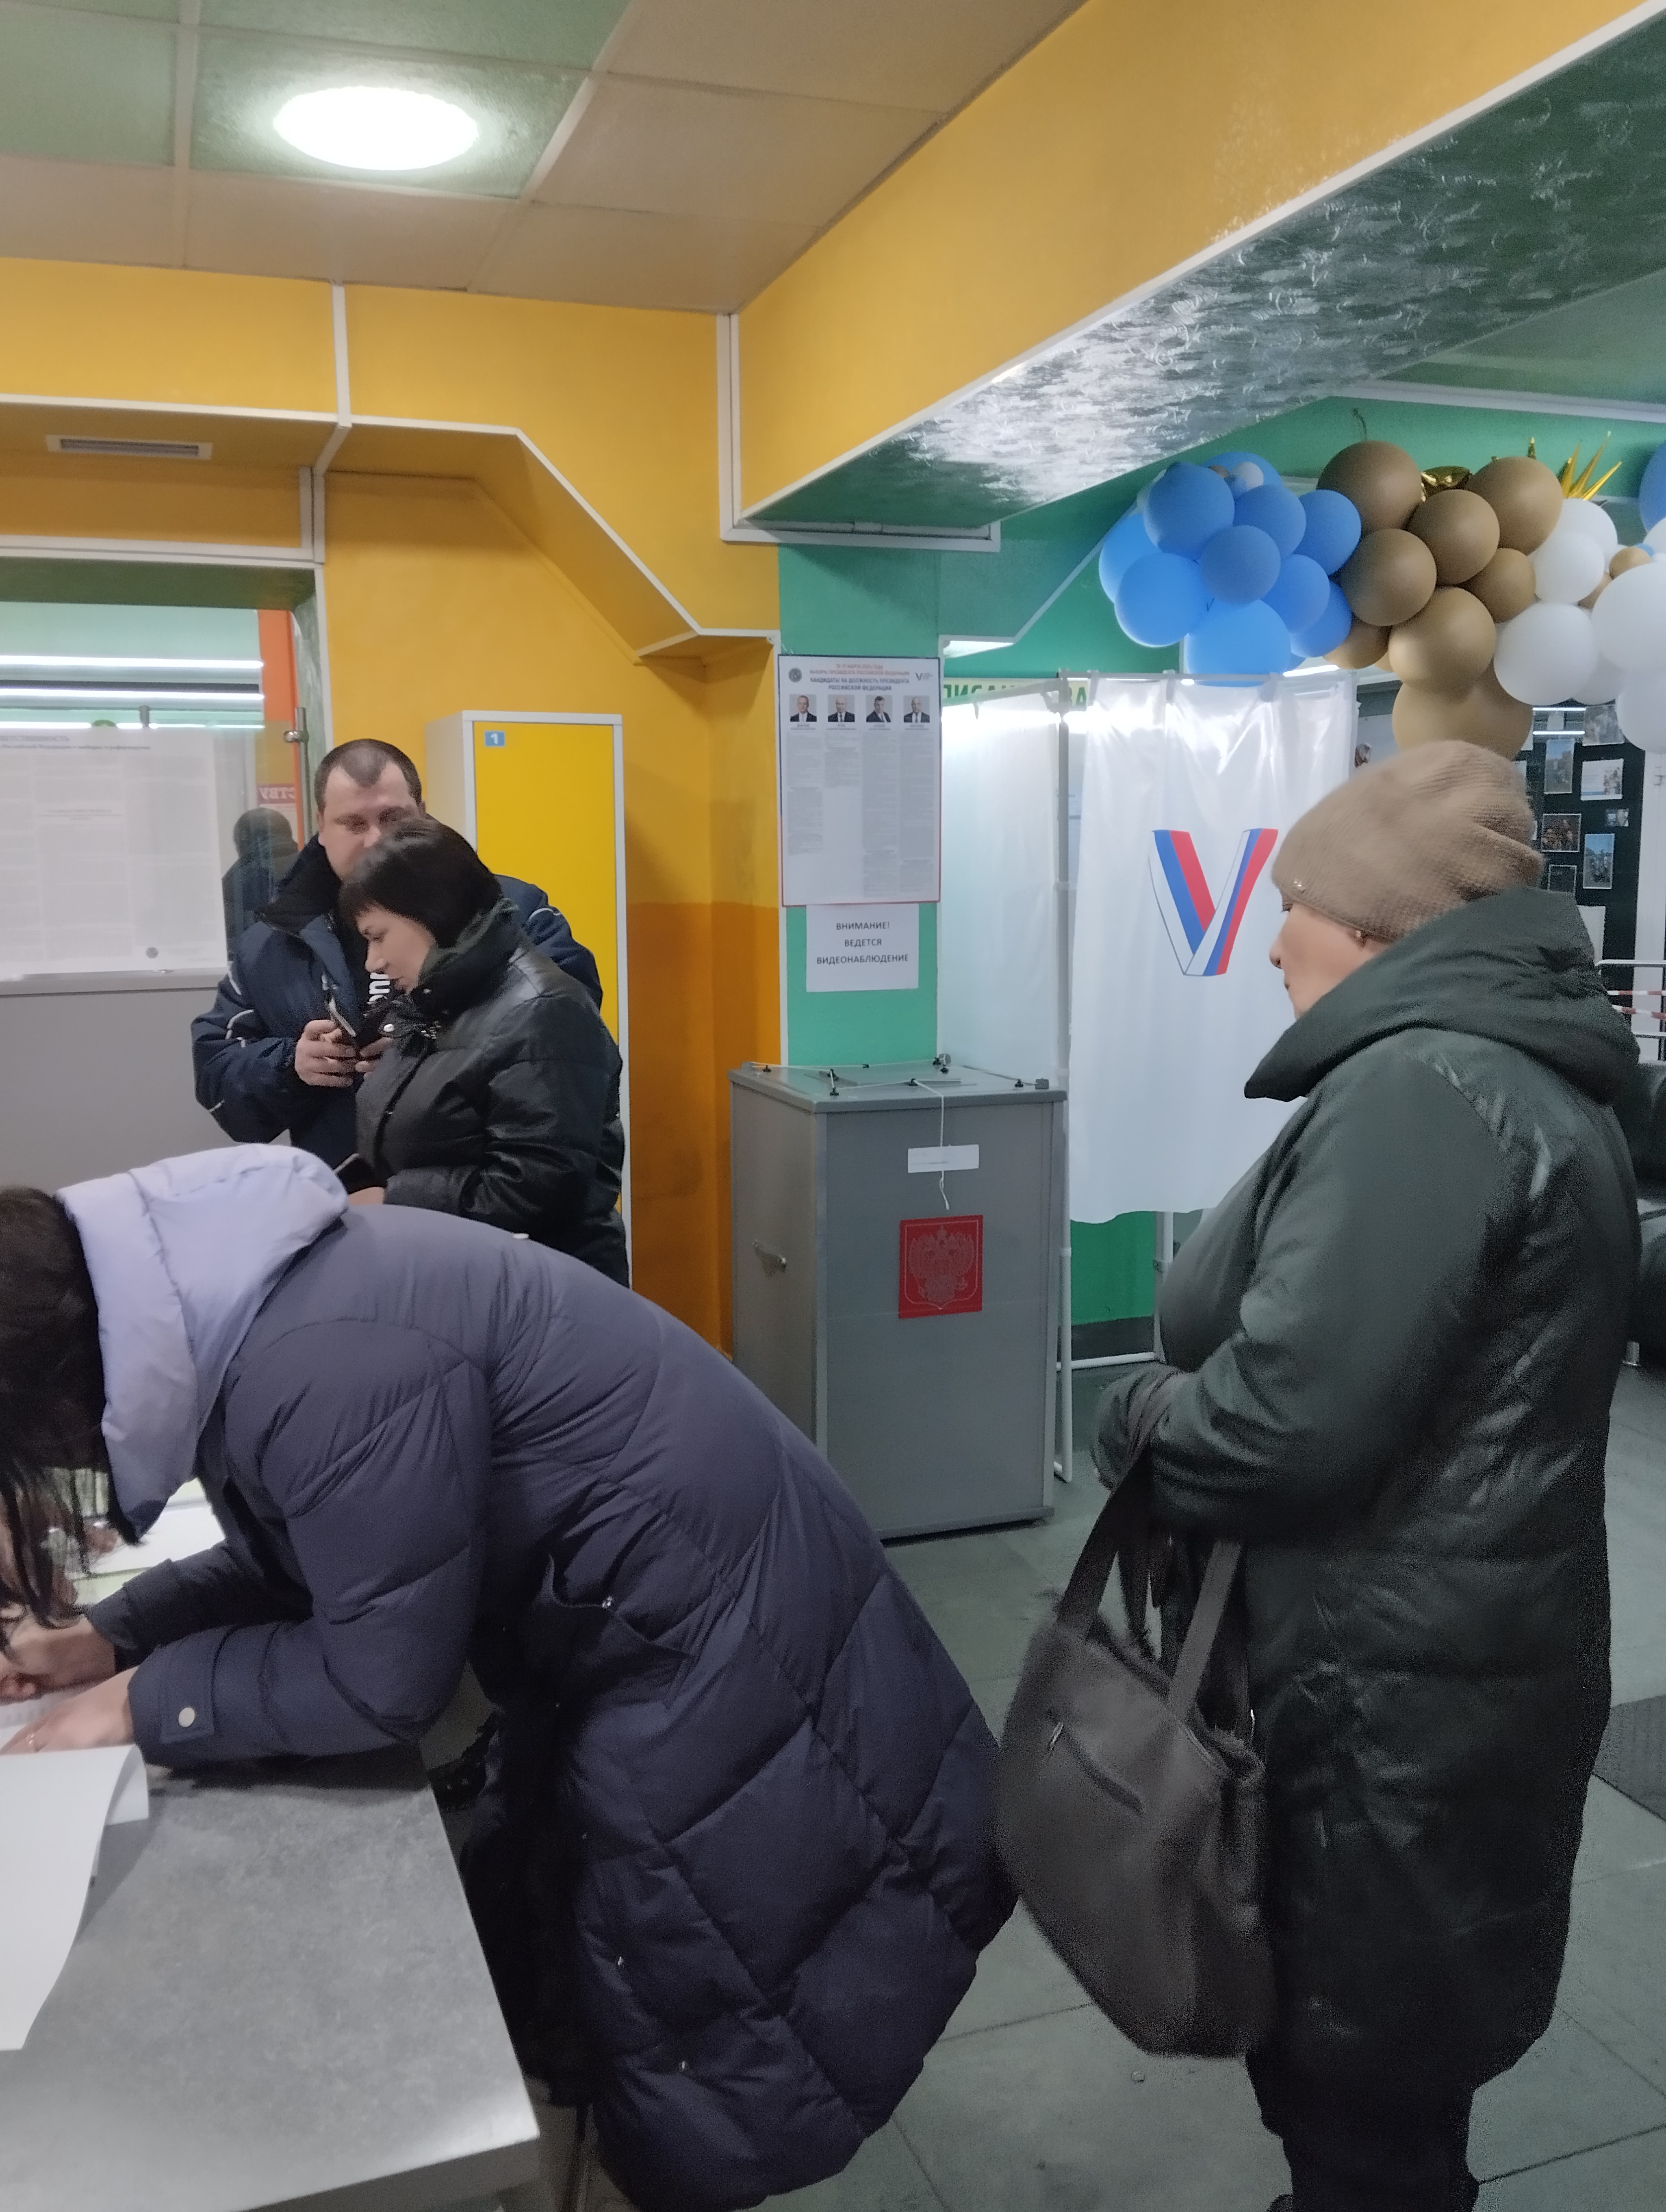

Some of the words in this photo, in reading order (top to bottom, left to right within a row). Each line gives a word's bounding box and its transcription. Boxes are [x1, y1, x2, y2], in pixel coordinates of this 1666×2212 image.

[490, 733, 498, 744] 1
[836, 922, 890, 930] ВНИМАНИЕ!
[844, 938, 882, 948] ВЕДЕТСЯ
[816, 954, 909, 965] ВИДЕОНАБЛЮДЕНИЕ
